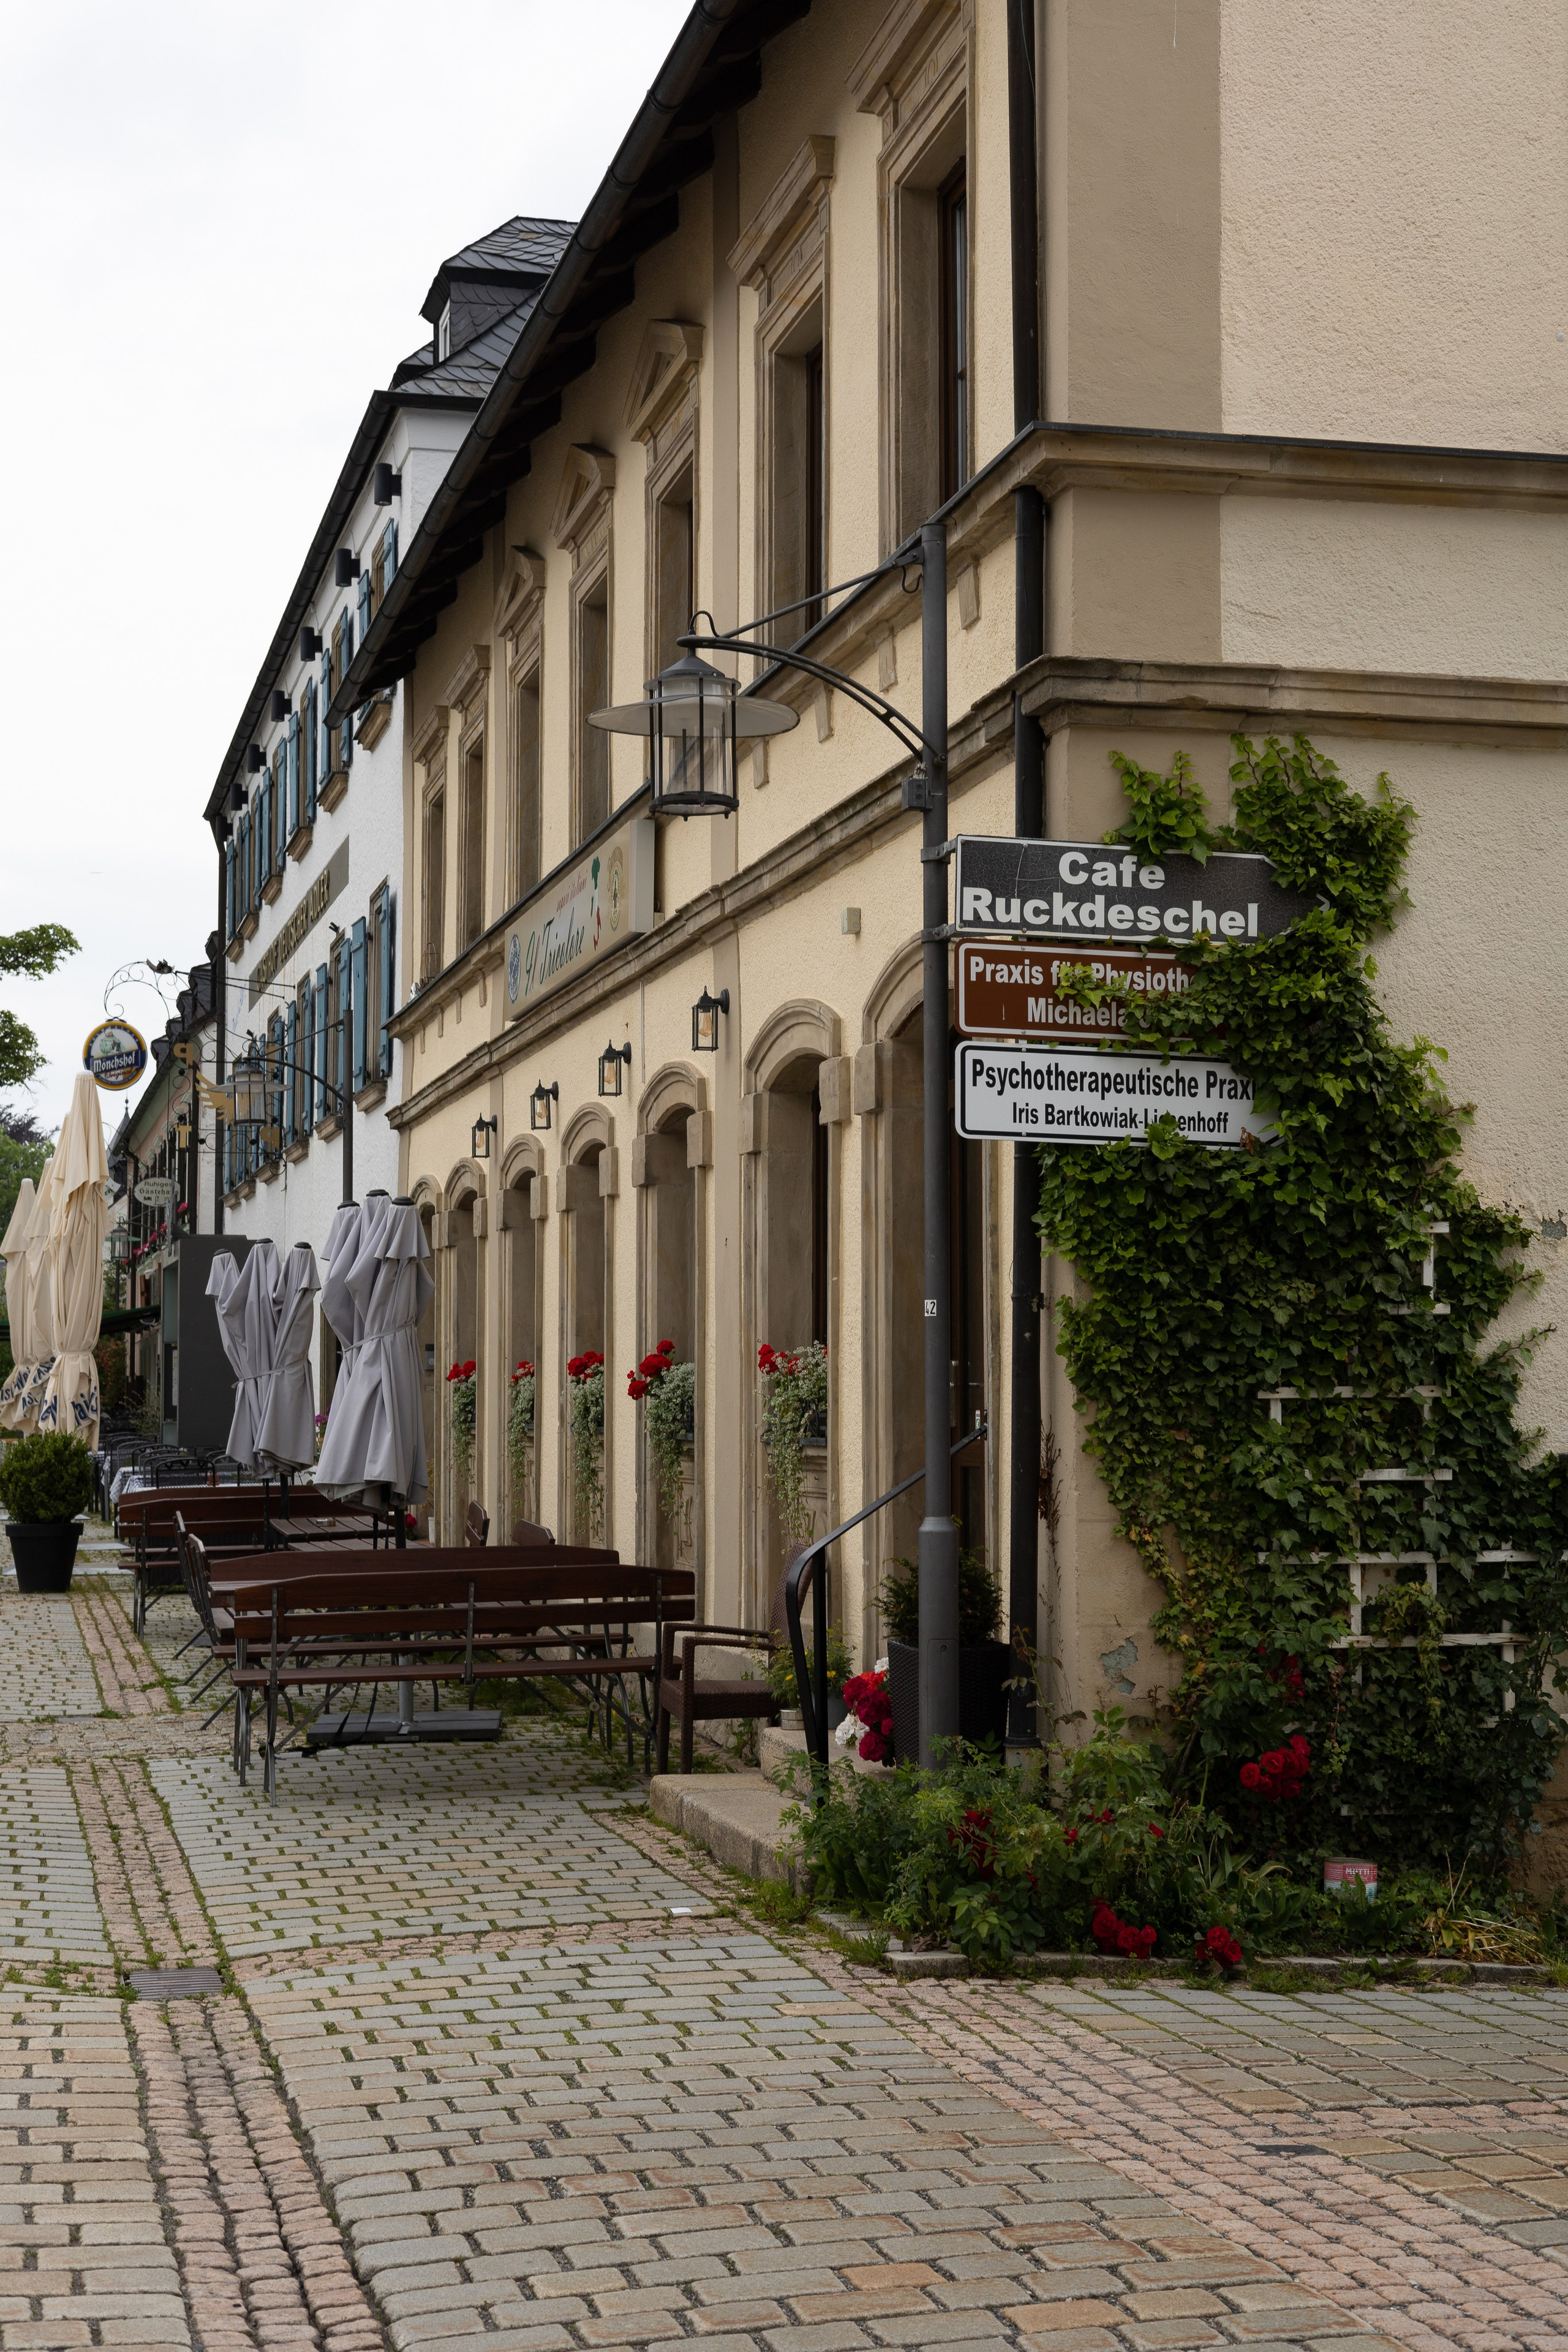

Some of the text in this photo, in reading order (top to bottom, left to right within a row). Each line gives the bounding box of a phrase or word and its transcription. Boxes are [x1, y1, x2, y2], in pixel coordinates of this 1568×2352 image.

[1058, 851, 1166, 889] Cafe
[279, 900, 308, 963] DEUTSCHER
[309, 869, 330, 923] ADLER
[962, 888, 1259, 937] Ruckdeschel
[539, 907, 585, 985] Tricolore
[970, 956, 1044, 985] Praxis
[1027, 997, 1128, 1027] Michaela
[93, 1052, 135, 1074] Mönchshof
[972, 1058, 1199, 1101] Psychotherapeutische
[1012, 1102, 1229, 1134] Iris Bartkowiak-Lienhoff
[925, 1301, 936, 1315] 42
